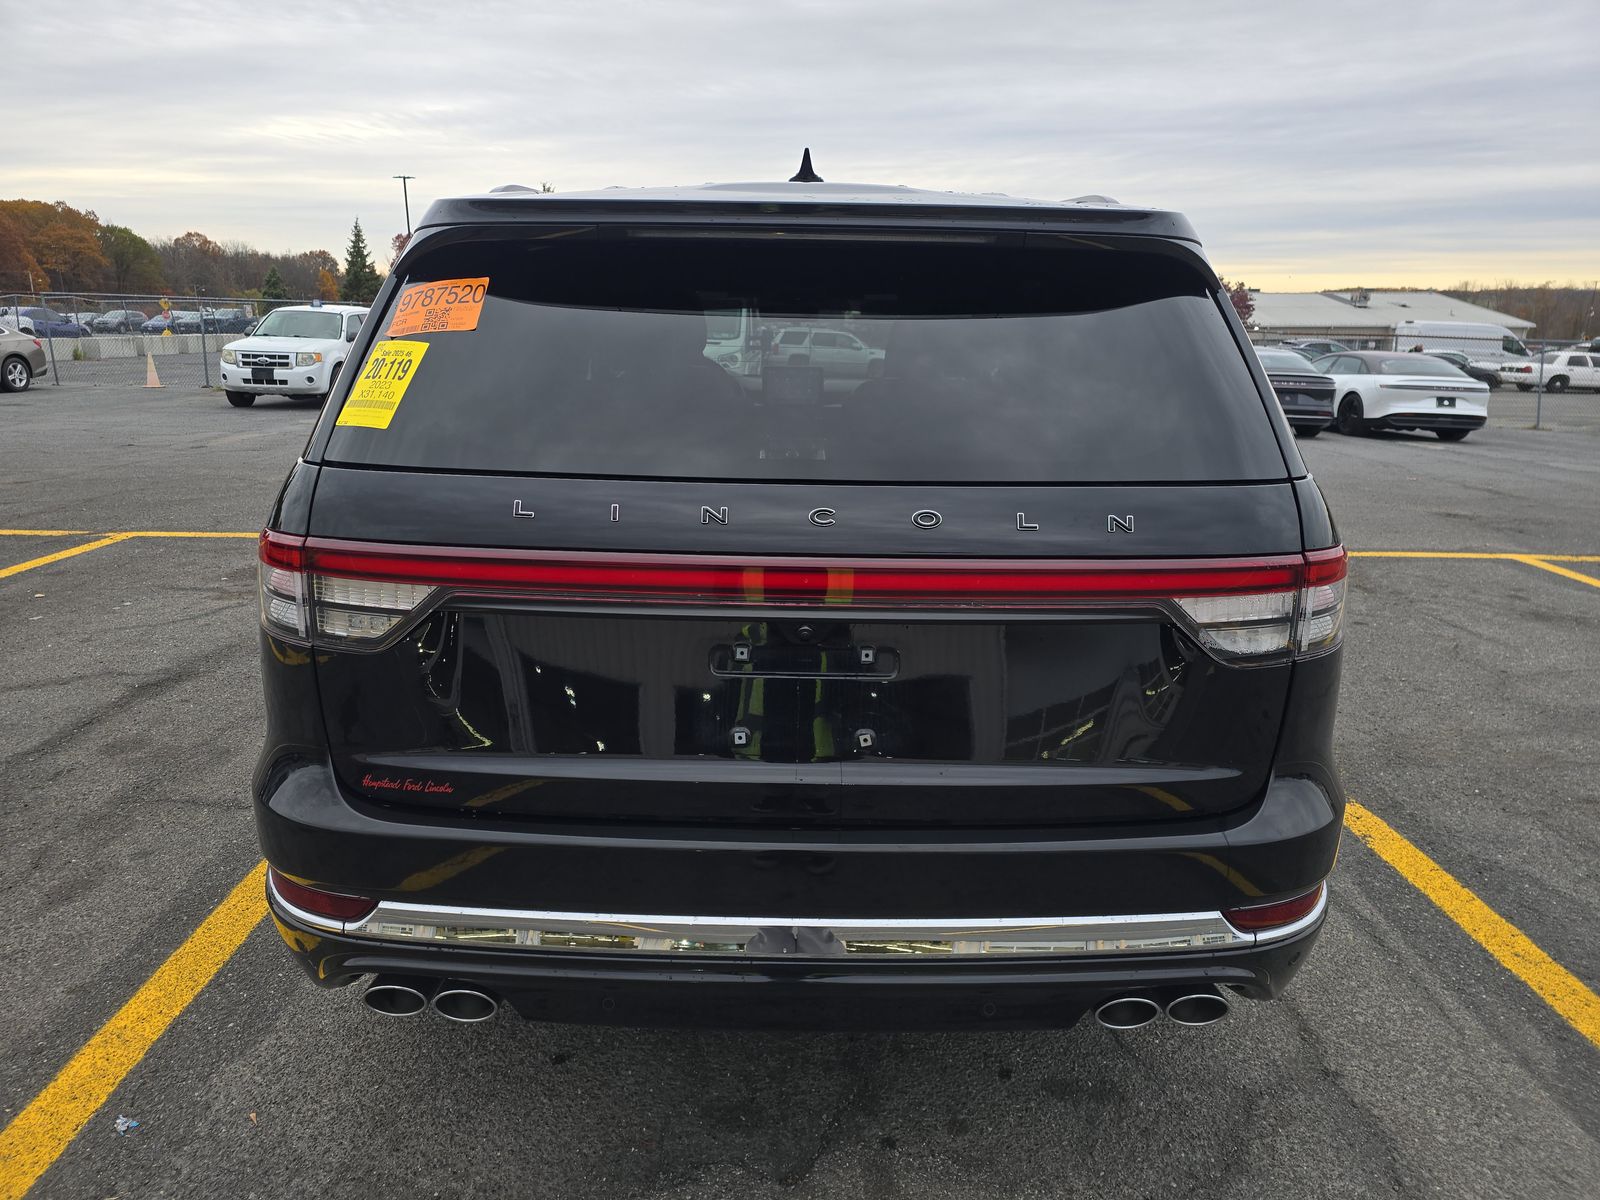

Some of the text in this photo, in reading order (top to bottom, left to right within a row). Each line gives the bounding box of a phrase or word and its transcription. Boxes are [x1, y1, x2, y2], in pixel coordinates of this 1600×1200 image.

[400, 284, 487, 312] 9787520
[365, 357, 413, 381] 20:119
[358, 389, 395, 400] X31,140
[369, 381, 392, 390] 2023
[513, 499, 1135, 533] LINCOLN
[403, 778, 422, 791] Ford
[424, 780, 454, 793] Lincoln
